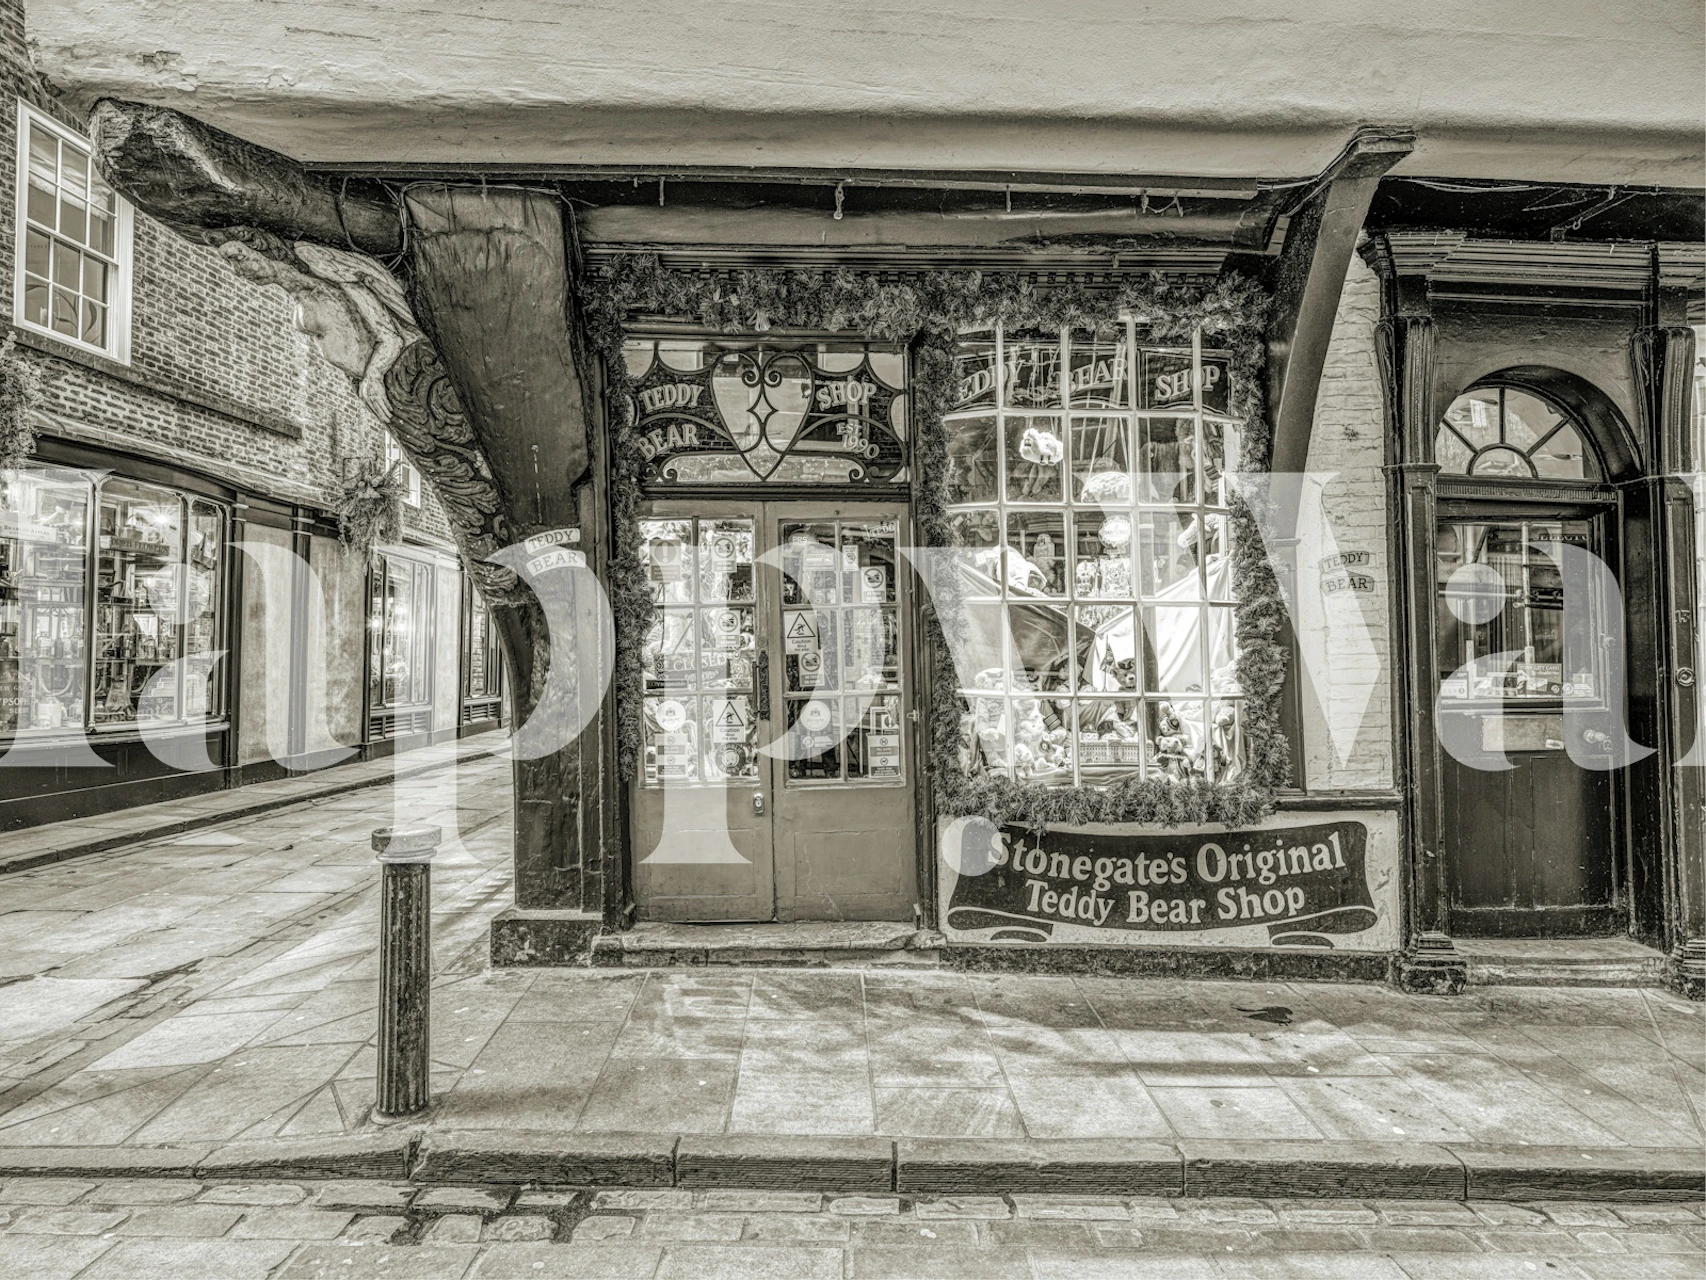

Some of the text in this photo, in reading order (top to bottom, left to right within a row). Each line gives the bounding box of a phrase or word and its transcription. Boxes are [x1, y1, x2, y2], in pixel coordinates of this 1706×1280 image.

[957, 359, 1220, 402] EDDY BEAR SHOP
[639, 383, 705, 413] TEDDY
[816, 381, 877, 411] SHOP
[637, 423, 700, 462] BEAR
[841, 435, 880, 460] 1990
[528, 530, 573, 549] TEDDY
[531, 552, 578, 572] BEAR
[1324, 552, 1363, 569] TEDDY
[1326, 577, 1368, 592] BEAR
[987, 831, 1347, 892] Stonegate's Original
[1025, 878, 1306, 926] Teddy Bear Shop
